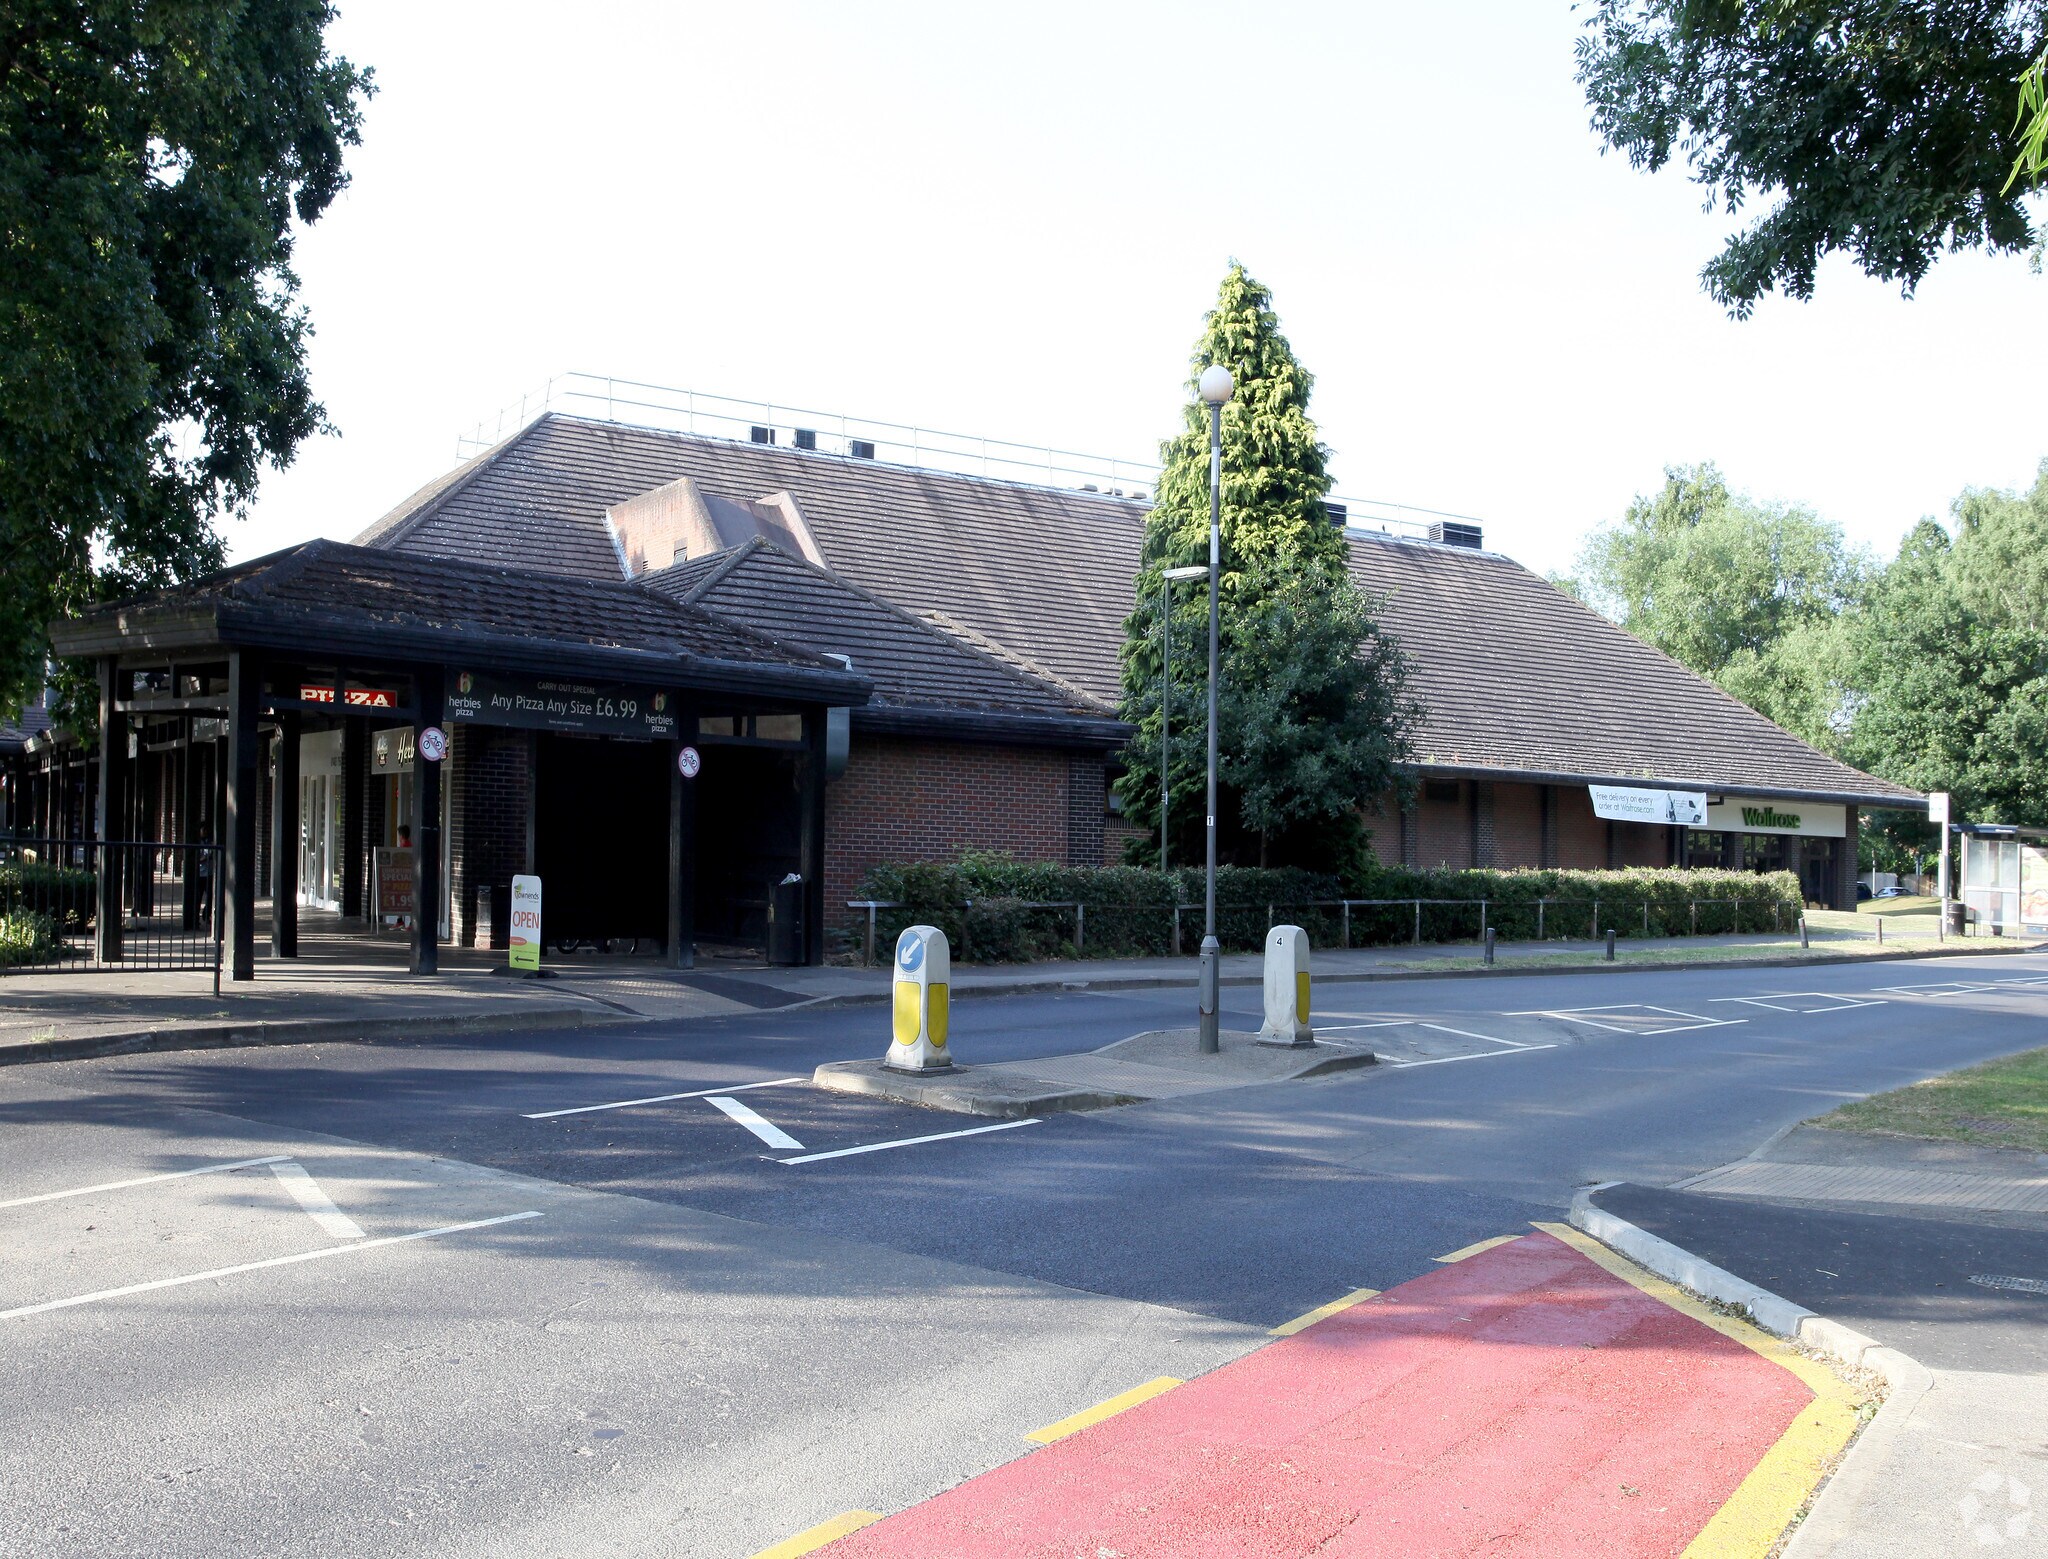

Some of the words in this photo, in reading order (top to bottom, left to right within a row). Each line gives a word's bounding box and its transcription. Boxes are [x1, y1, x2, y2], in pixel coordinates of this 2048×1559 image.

[537, 681, 558, 691] CARRY
[558, 683, 571, 692] OUT
[572, 684, 596, 695] SPECIAL
[448, 695, 482, 709] herbies
[491, 693, 513, 710] Any
[516, 696, 544, 711] Pizza
[547, 698, 567, 716] Any
[570, 700, 592, 715] Size
[595, 697, 638, 719] £6.99
[455, 707, 474, 717] pizza
[645, 713, 674, 726] herbies
[651, 724, 667, 733] pizza
[397, 732, 415, 763] Herb
[1596, 791, 1607, 800] Free
[1608, 792, 1629, 804] delivery
[1638, 796, 1654, 805] every
[1598, 802, 1612, 810] order
[1613, 803, 1620, 811] at
[1620, 803, 1655, 814] Waitrose.com
[1741, 807, 1801, 829] Waitrose
[514, 889, 540, 901] Townends
[512, 910, 540, 929] OPEN
[1276, 937, 1283, 946] 4
